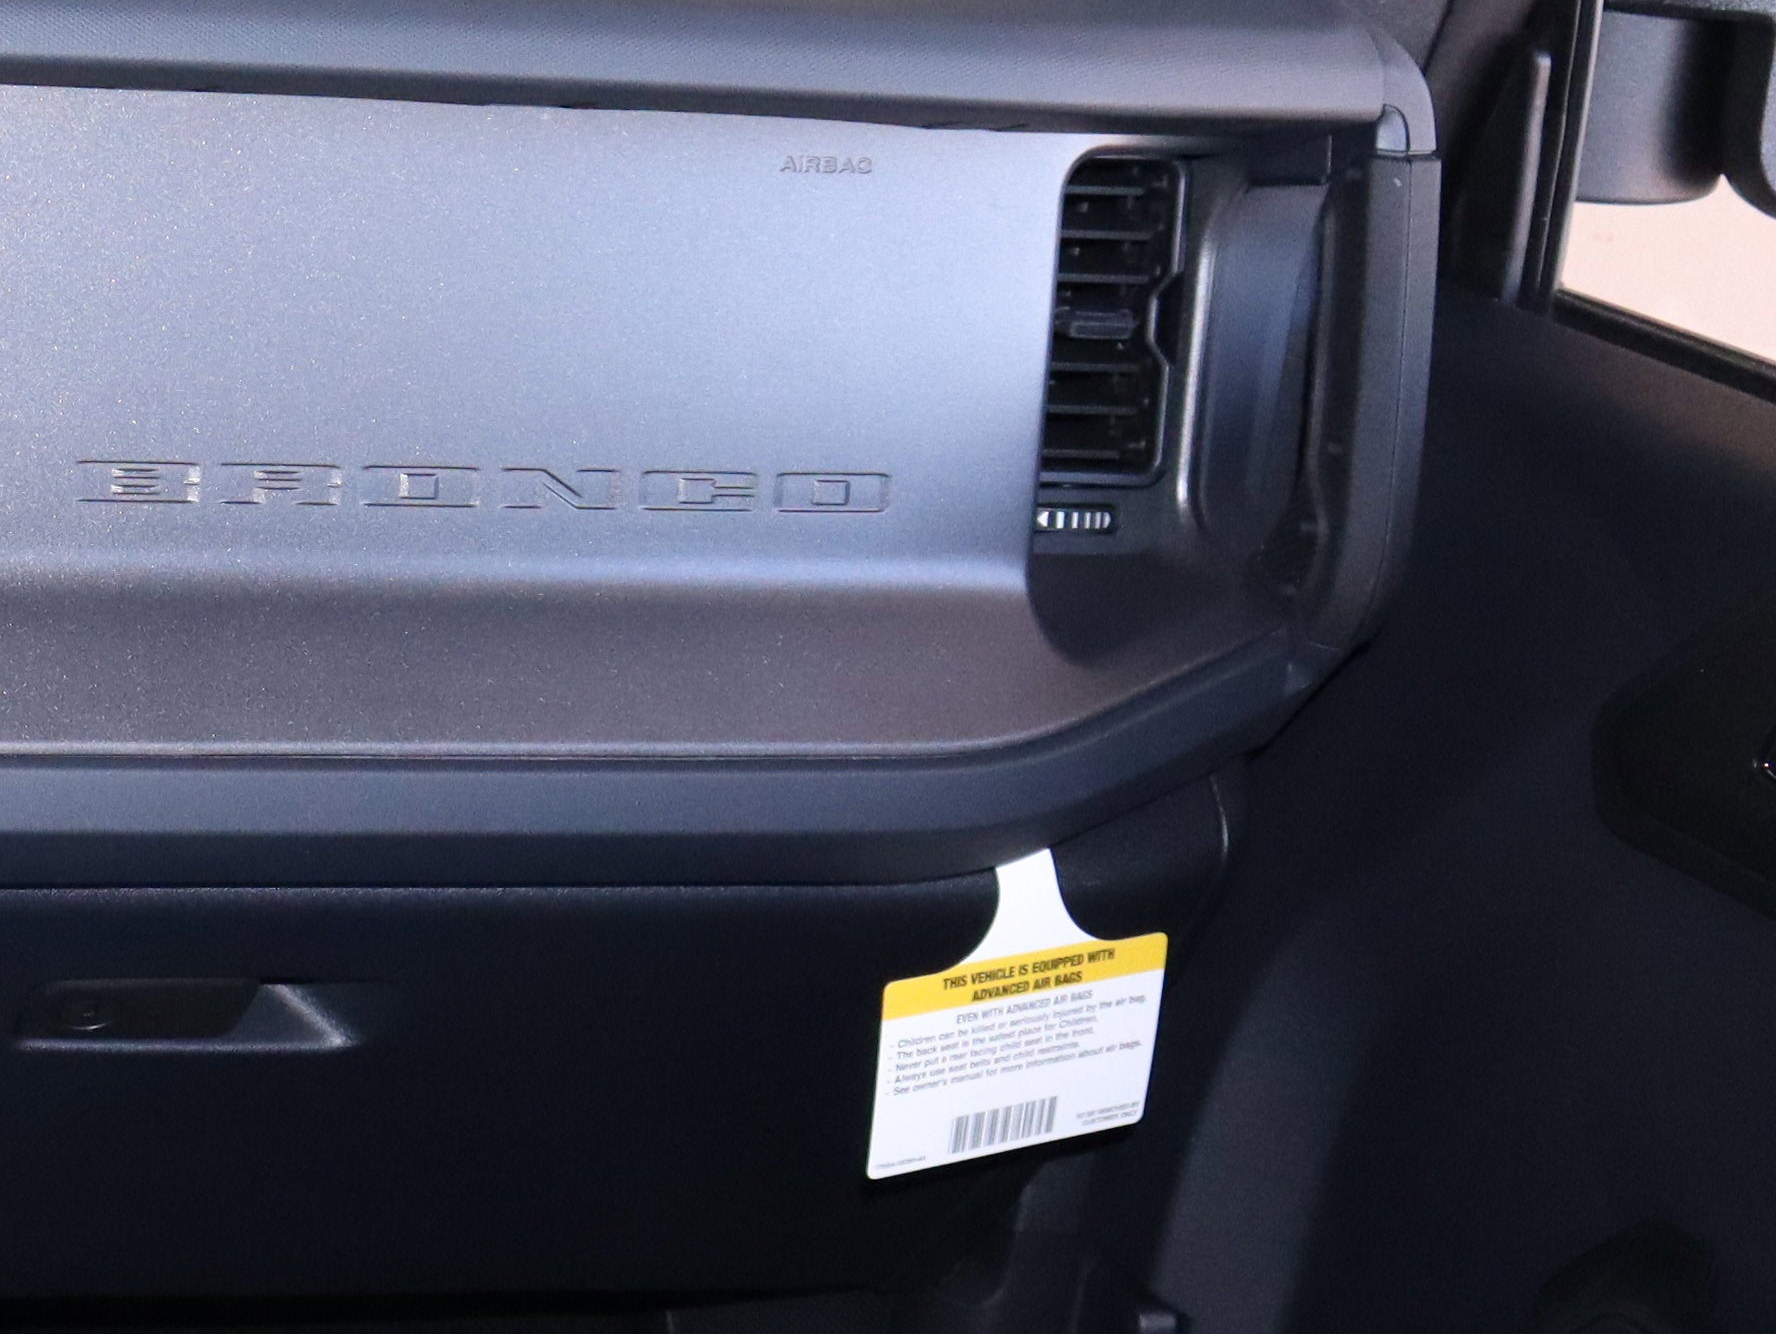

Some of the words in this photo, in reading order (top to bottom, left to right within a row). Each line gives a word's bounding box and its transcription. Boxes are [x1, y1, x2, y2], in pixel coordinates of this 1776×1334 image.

[943, 975, 967, 990] THIS
[971, 966, 1015, 985] VEHICLE
[1018, 963, 1028, 975] IS
[1032, 953, 1084, 974] EQUIPPED
[1087, 948, 1116, 963] WITH
[972, 982, 1030, 1002] ADVANCED
[1033, 976, 1051, 990] AIR
[1054, 970, 1083, 986] BAGS
